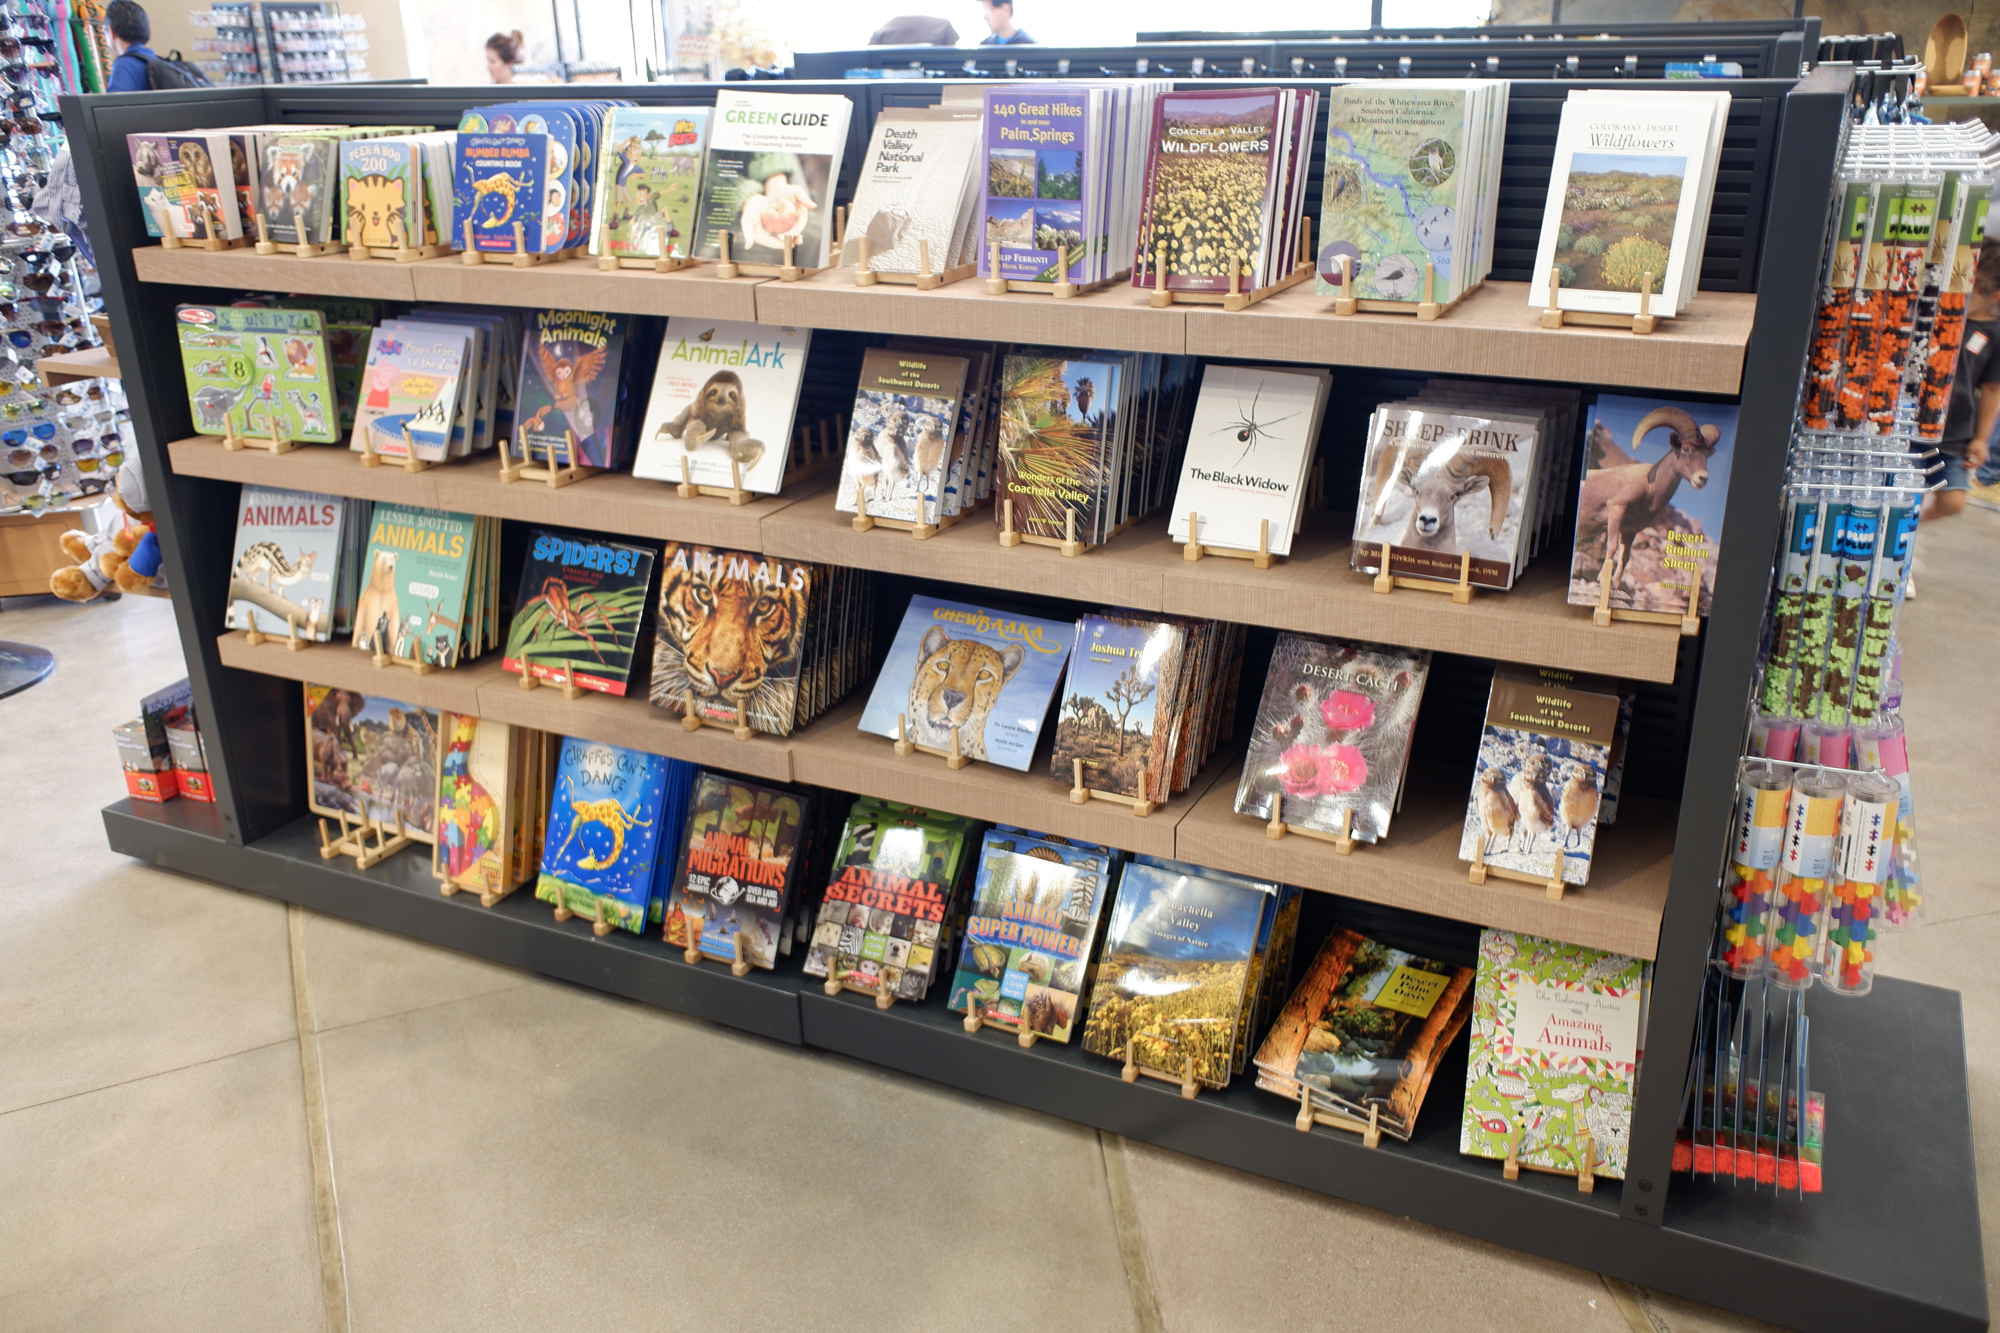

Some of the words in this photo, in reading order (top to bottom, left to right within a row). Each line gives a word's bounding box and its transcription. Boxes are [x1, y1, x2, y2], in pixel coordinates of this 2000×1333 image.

[993, 104, 1016, 118] 140
[1018, 102, 1050, 116] Great
[1052, 103, 1082, 116] Hikes
[1344, 97, 1364, 105] Birds
[1389, 98, 1432, 106] Whitewater
[1433, 99, 1454, 108] River,
[726, 110, 778, 125] GREEN
[780, 112, 829, 127] GUIDE
[1396, 108, 1436, 116] California:
[675, 119, 696, 134] WILD
[1358, 116, 1394, 124] Disturbed
[1396, 117, 1445, 126] Environment
[1590, 123, 1641, 131] COLORADO
[1646, 124, 1680, 132] DESERT
[884, 128, 918, 139] Death
[1000, 127, 1030, 140] Palm
[1032, 128, 1075, 144] Springs
[1169, 127, 1226, 136] COACHELLA
[1230, 126, 1265, 135] VALLEY
[1373, 128, 1393, 136] Robert
[883, 140, 913, 153] Valley
[1161, 140, 1270, 152] WILDFLOWERS
[1590, 133, 1675, 150] Wildflowers
[465, 148, 500, 158] NUMBER
[501, 148, 530, 158] RUMBA
[878, 151, 924, 162] National
[475, 160, 504, 168] COUNTING
[505, 160, 522, 168] BOOK
[875, 162, 900, 173] Park
[1902, 214, 1931, 225] PLUS
[1900, 224, 1930, 234] PLUS
[1014, 253, 1048, 264] FERRANTI
[538, 310, 617, 334] Moonlight
[541, 326, 608, 348] Animals
[406, 340, 430, 356] Peppa
[434, 342, 456, 356] Goes
[234, 361, 245, 378] 8
[408, 358, 418, 367] to
[422, 358, 436, 368] the
[439, 358, 457, 371] Zoo
[899, 360, 926, 370] Wildlife
[878, 377, 913, 388] Southwest
[914, 381, 940, 390] Deserts
[1383, 420, 1445, 442] SHEP
[1018, 470, 1054, 483] Wonders
[1056, 476, 1064, 484] of
[1066, 476, 1081, 487] the
[1190, 468, 1212, 480] The
[1212, 471, 1244, 486] Black
[1245, 476, 1290, 492] Widow
[1008, 482, 1055, 498] Coachella
[1058, 489, 1090, 505] Valley
[242, 504, 335, 526] ANIMALS
[424, 506, 450, 518] MORE
[380, 510, 414, 525] LESSER
[418, 516, 462, 533] SPOTTED
[372, 522, 465, 559] ANIMALS
[1668, 530, 1704, 544] Desert
[1847, 530, 1874, 542] PLUS
[1666, 544, 1709, 558] Bighorn
[1846, 540, 1872, 550] PLUS
[532, 536, 641, 577] SPIDERS!
[1360, 549, 1368, 557] by
[1391, 553, 1416, 564] Rivkin
[1417, 558, 1430, 566] with
[1432, 560, 1452, 570] Roland
[1483, 568, 1498, 576] DVM
[671, 549, 804, 591] ANIMALS
[1663, 557, 1697, 572] Sheep
[562, 567, 590, 576] STRANGE
[591, 571, 604, 580] AND
[563, 574, 600, 586] WONDERFUL
[933, 607, 1061, 654] CHEWBAAKA
[1090, 642, 1126, 656] Joshua
[1303, 663, 1350, 681] DESERT
[1356, 674, 1398, 692] CACTI
[1540, 669, 1574, 682] Wildlife
[1536, 695, 1572, 709] Wildlife
[1540, 708, 1549, 716] of
[1550, 709, 1564, 718] the
[1510, 712, 1554, 727] Southwest
[1557, 720, 1591, 734] Deserts
[564, 746, 614, 766] GIRAFFES
[617, 754, 646, 777] CAN'T
[580, 770, 626, 794] DANCE
[704, 830, 750, 856] ANIMAL
[688, 847, 787, 888] MIGRATIONS
[689, 874, 696, 882] 12
[697, 874, 711, 886] EPIC
[840, 866, 943, 904] ANIMAL
[748, 885, 762, 895] OVER
[746, 894, 756, 903] SEA
[757, 896, 768, 906] AND
[768, 899, 778, 908] AIR
[829, 882, 946, 922] SECRETS
[1003, 900, 1063, 930] ANIMAL
[1164, 900, 1214, 919] Coachella
[1170, 915, 1200, 932] Valley
[968, 916, 1019, 943] SUPER
[1022, 925, 1088, 958] POWERS
[1154, 930, 1176, 942] Images
[1178, 935, 1186, 944] of
[1186, 936, 1209, 948] Nature
[1400, 973, 1439, 988] Desert
[1400, 981, 1430, 994] Palm
[1394, 988, 1426, 1002] Oasis
[1535, 990, 1551, 1001] The
[1554, 992, 1590, 1012] Coloring
[1595, 998, 1620, 1011] Studio
[1546, 1013, 1604, 1034] Amazing
[1537, 1027, 1612, 1052] Animals
